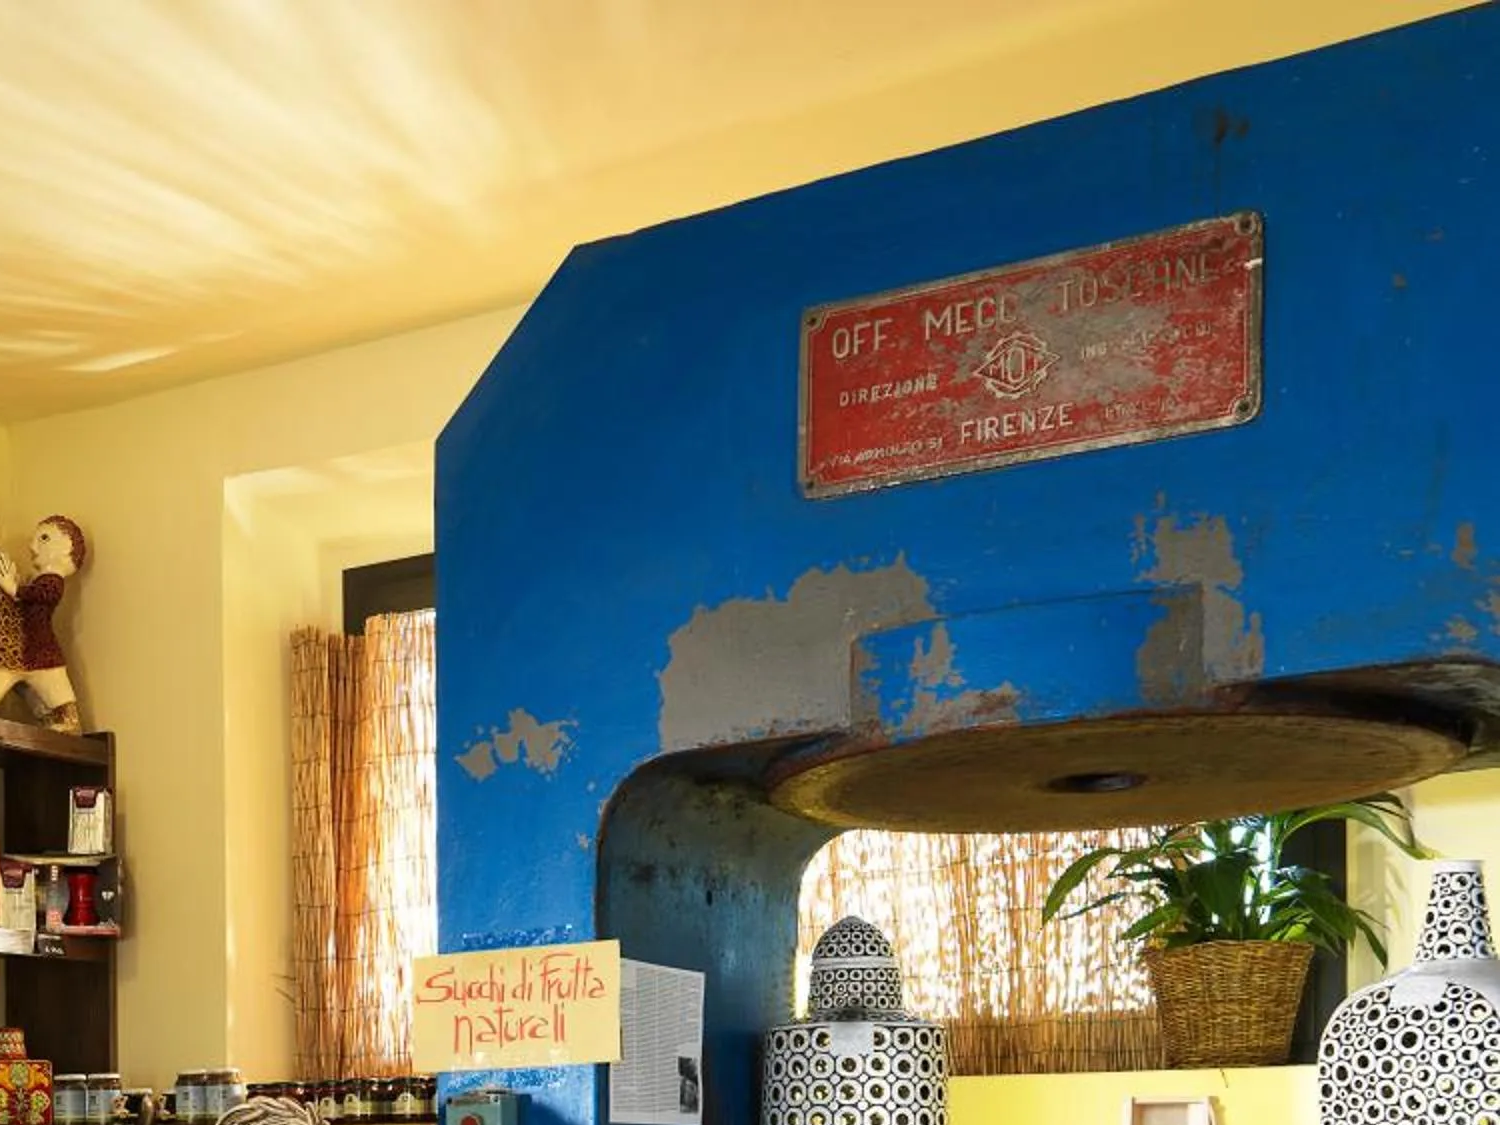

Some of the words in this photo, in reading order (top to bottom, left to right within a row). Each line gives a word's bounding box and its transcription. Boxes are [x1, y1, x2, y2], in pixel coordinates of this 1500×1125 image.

[832, 317, 893, 360] OFF
[839, 374, 938, 408] DIREZIONE
[959, 404, 1074, 447] FIRENZE
[416, 963, 505, 1007] Succhi
[511, 957, 533, 1002] di
[539, 953, 606, 1005] Frutta
[453, 1002, 566, 1056] naturali
